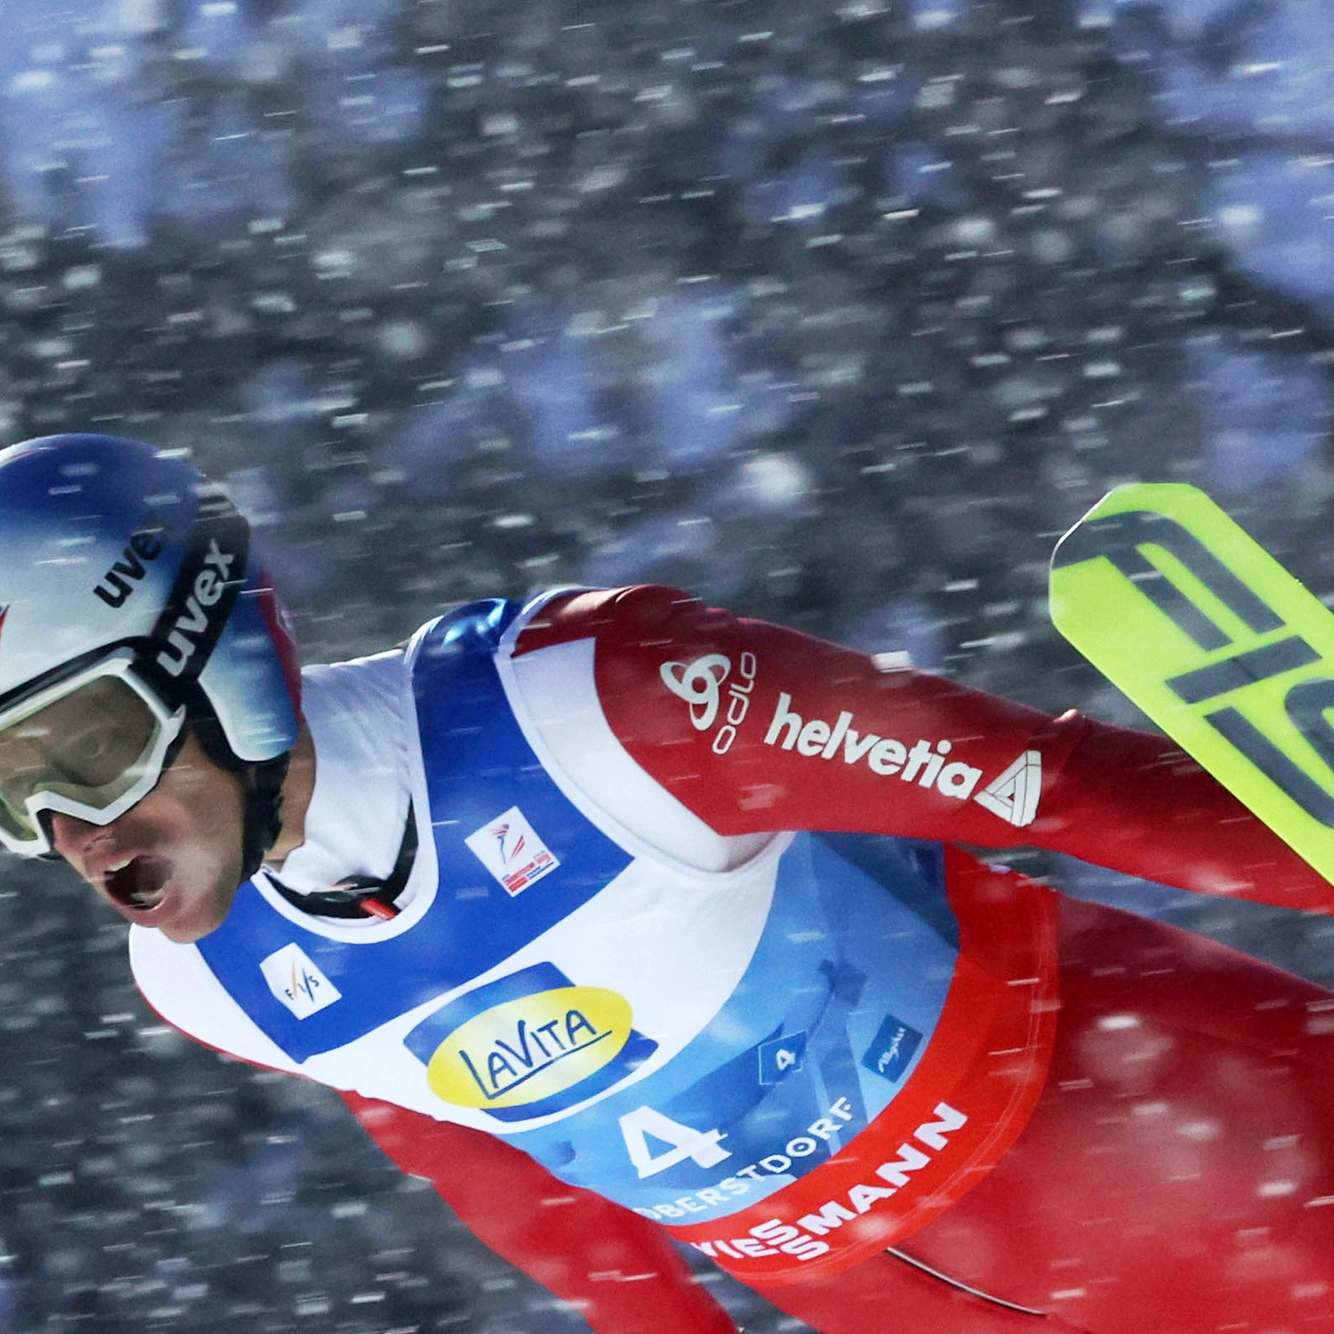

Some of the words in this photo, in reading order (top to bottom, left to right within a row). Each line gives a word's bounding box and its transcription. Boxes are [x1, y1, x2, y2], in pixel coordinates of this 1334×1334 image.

[93, 522, 165, 609] uve
[156, 537, 234, 677] uvex
[763, 691, 984, 801] helvetia
[776, 1048, 796, 1071] 4
[618, 1105, 733, 1180] 4
[689, 1101, 969, 1261] VIESSMANN
